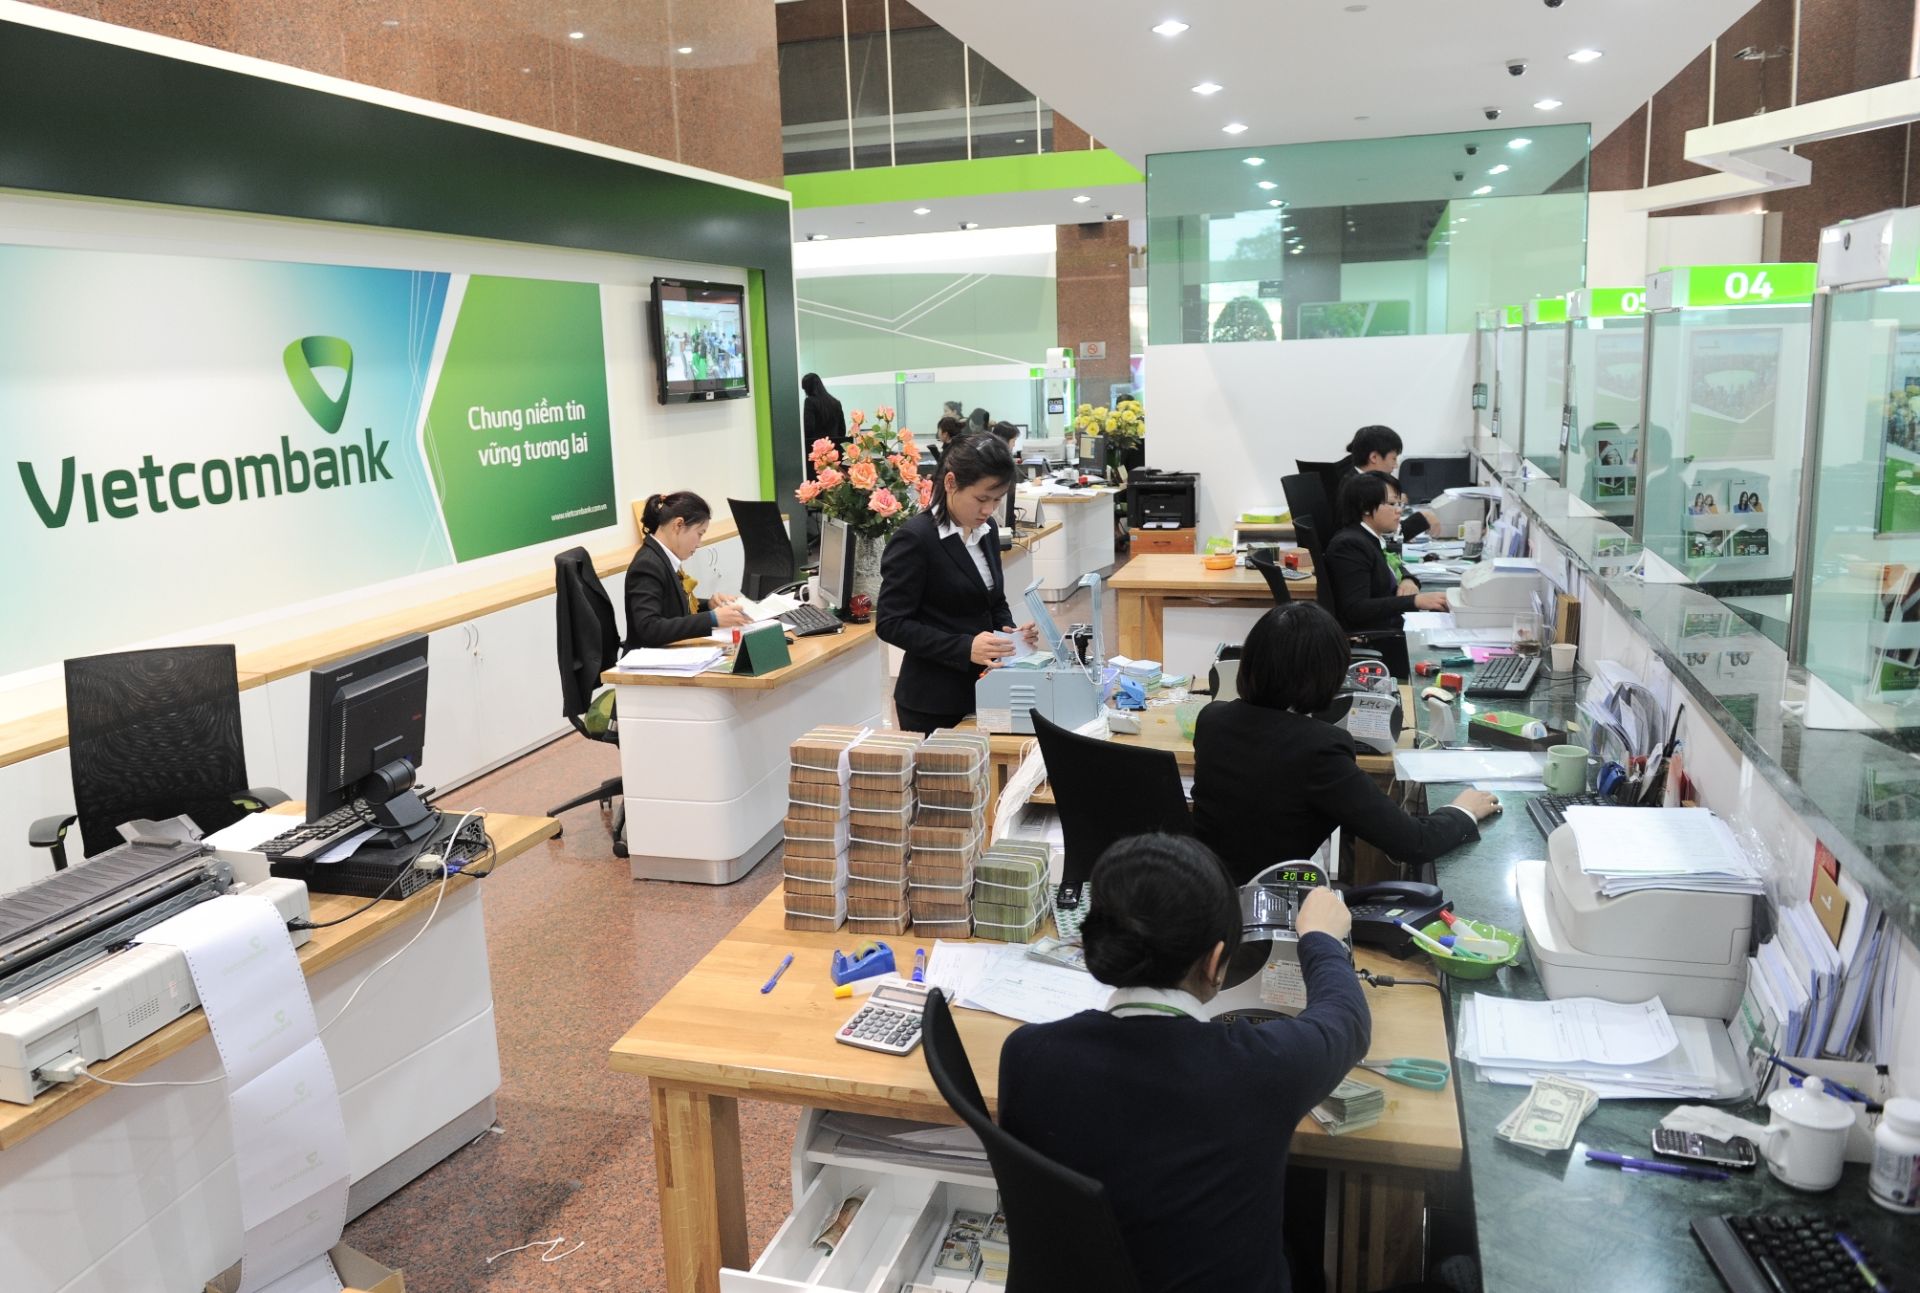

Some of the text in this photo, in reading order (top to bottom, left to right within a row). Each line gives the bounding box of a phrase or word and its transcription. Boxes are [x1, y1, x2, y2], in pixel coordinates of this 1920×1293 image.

[1724, 271, 1774, 300] 04
[467, 397, 585, 431] Chung niềm tin
[478, 432, 588, 467] vững tương lai
[16, 428, 394, 529] Vietcombank
[1283, 871, 1317, 882] 20 85
